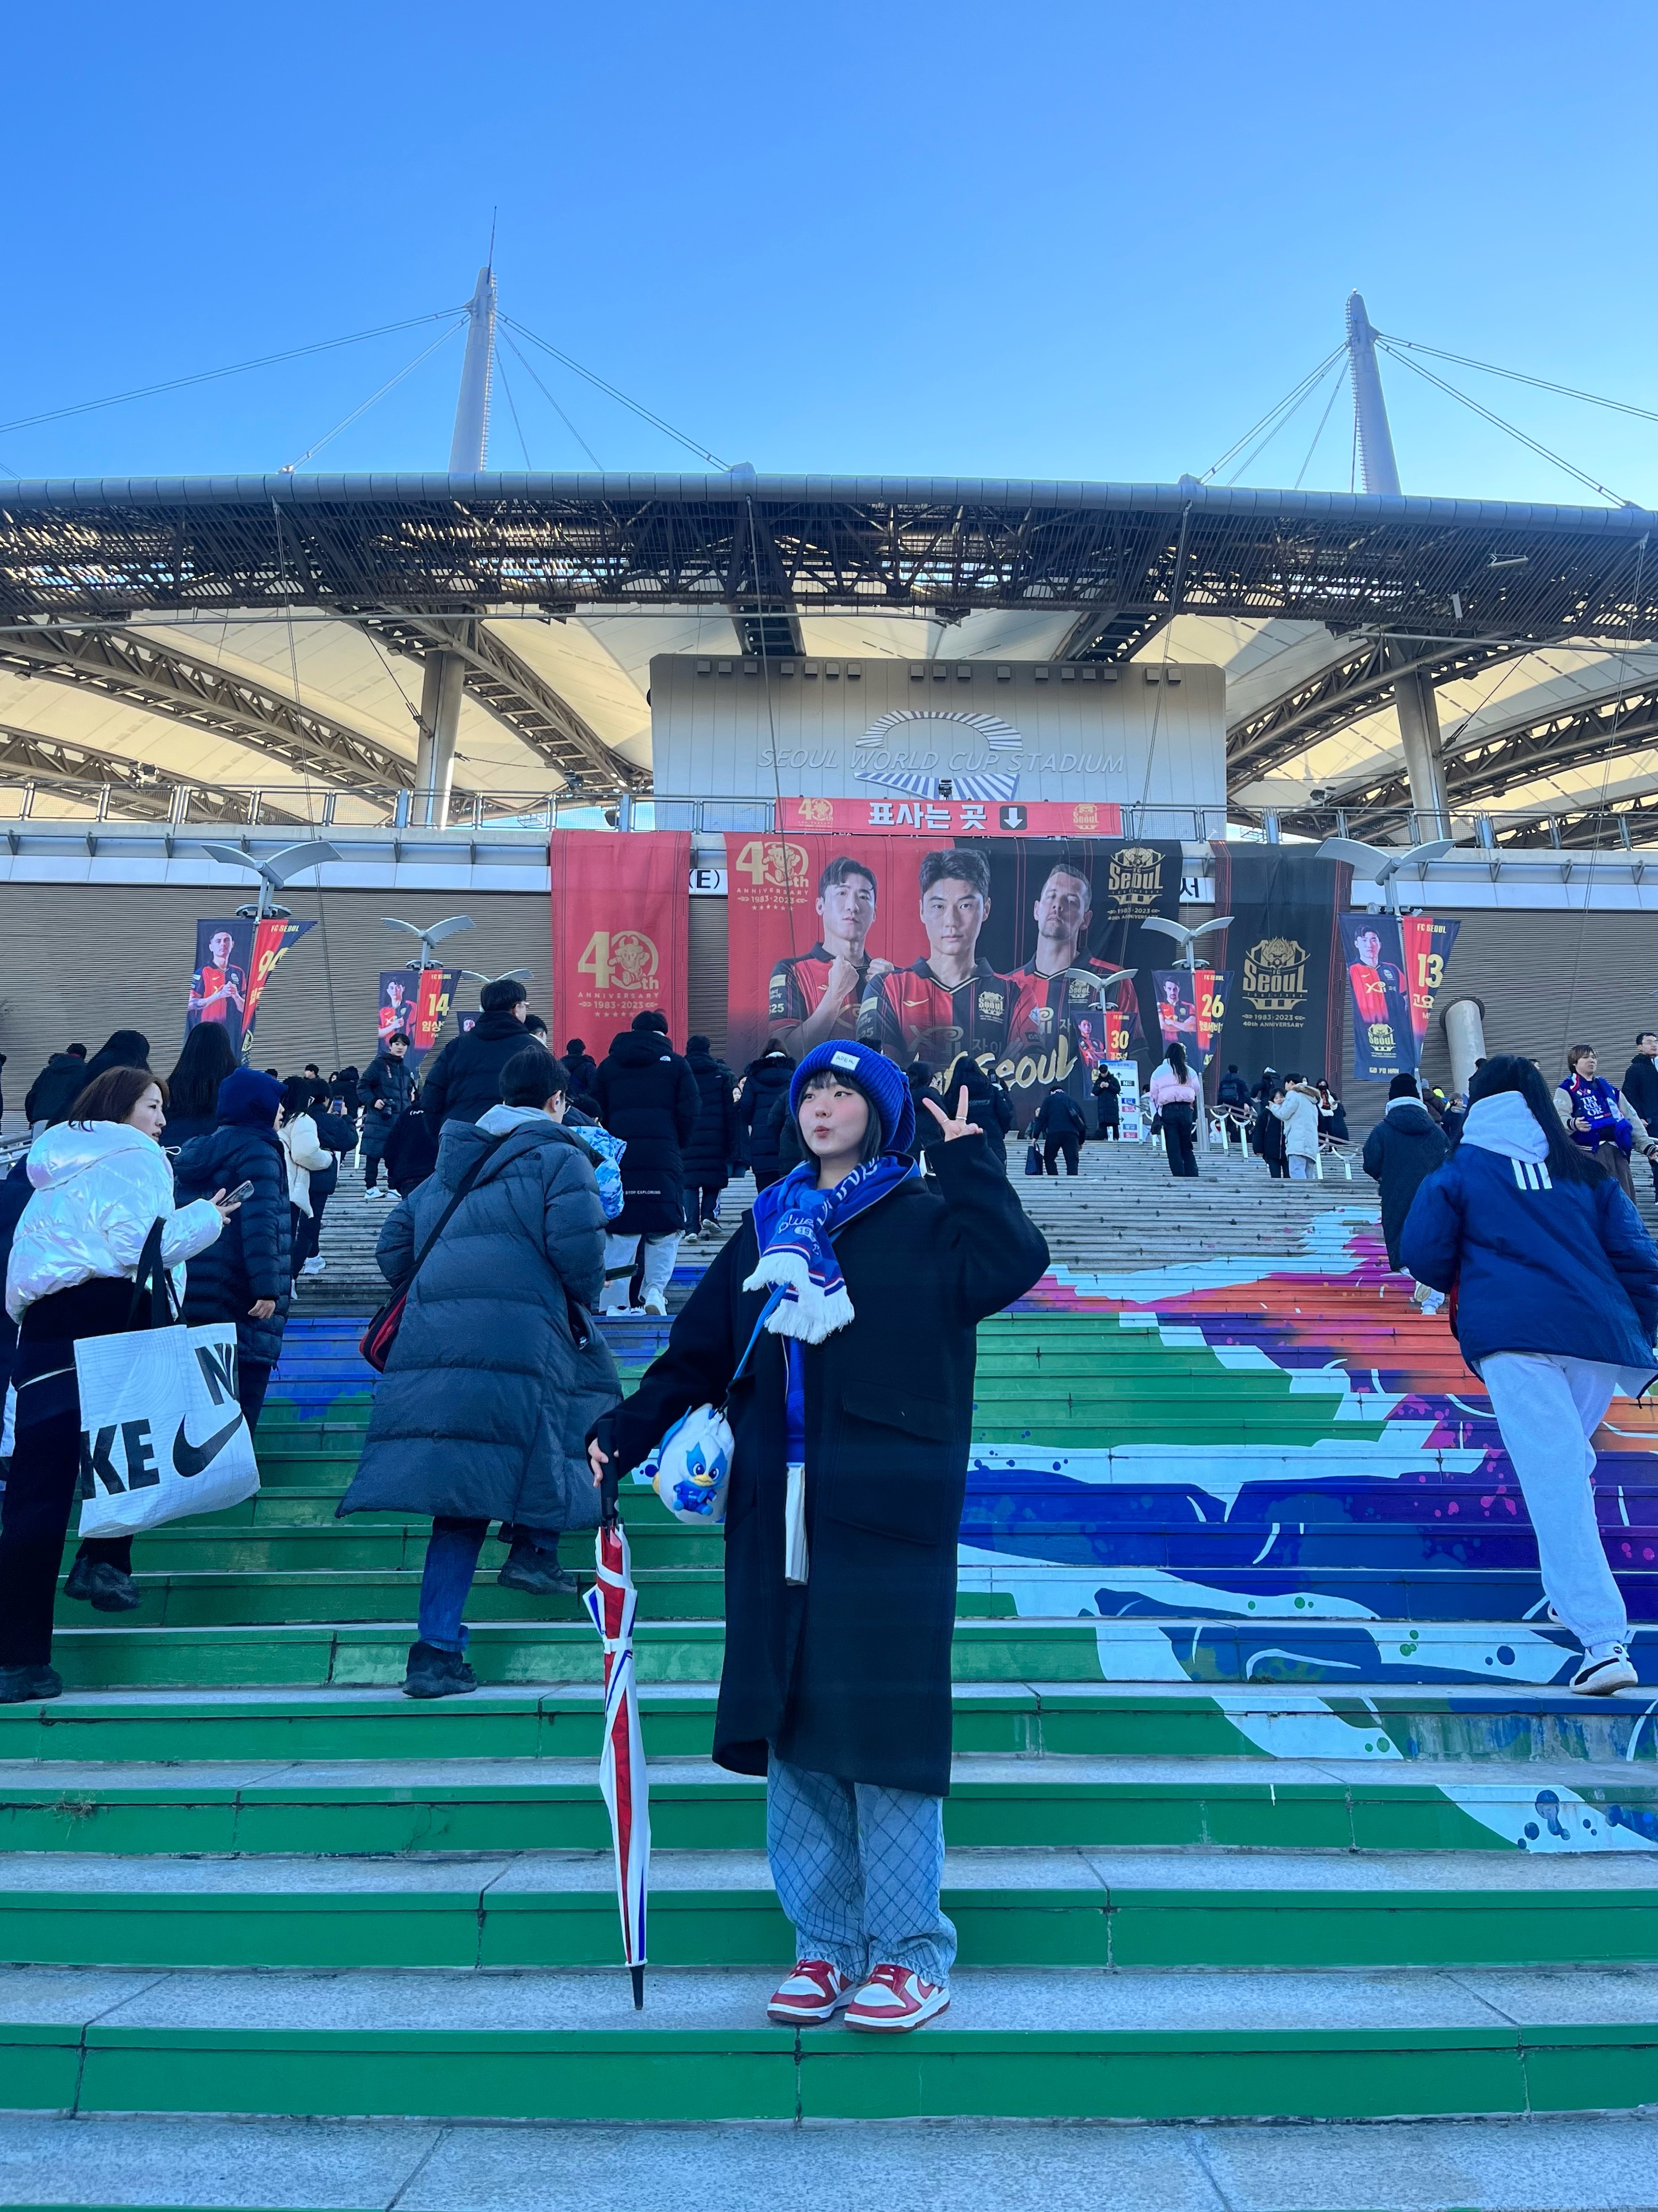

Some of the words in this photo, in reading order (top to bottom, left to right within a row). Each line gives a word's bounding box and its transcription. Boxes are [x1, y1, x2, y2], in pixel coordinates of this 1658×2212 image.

[757, 748, 839, 768] SEOUL
[850, 751, 940, 771] WORLD
[948, 752, 1000, 772] CUP
[1007, 753, 1124, 773] STADIUM
[868, 802, 951, 830] 표사는
[959, 804, 987, 830] 곳
[1108, 862, 1164, 891] Seoul
[737, 888, 809, 896] ANNIVERSARY
[271, 925, 279, 933] FC
[1417, 923, 1425, 931] FC
[1426, 924, 1447, 934] SEOUL
[578, 930, 659, 990] 40th
[1417, 953, 1444, 988] 13
[1243, 959, 1308, 993] Seoul
[428, 993, 450, 1016] 14
[1201, 994, 1225, 1018] 26
[1111, 1030, 1130, 1050] 30
[1580, 1095, 1598, 1106] TRI
[1587, 1107, 1604, 1116] OR
